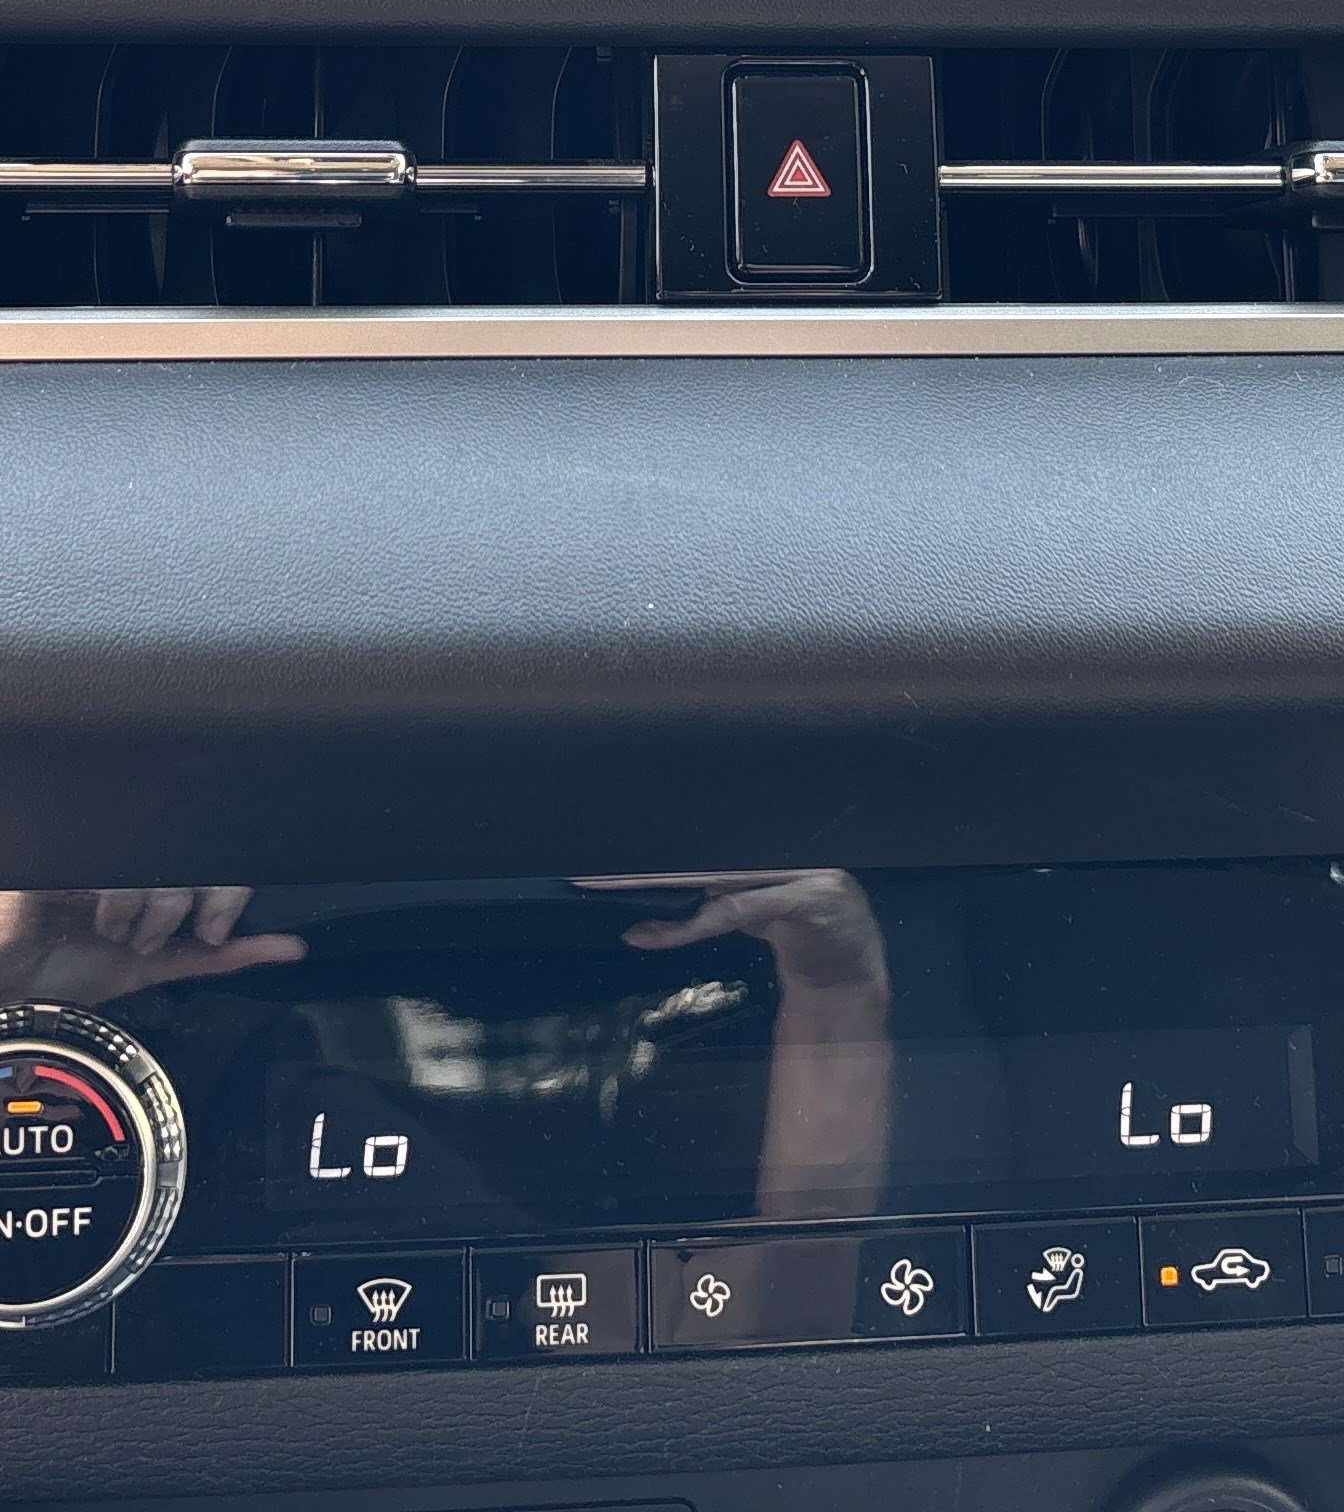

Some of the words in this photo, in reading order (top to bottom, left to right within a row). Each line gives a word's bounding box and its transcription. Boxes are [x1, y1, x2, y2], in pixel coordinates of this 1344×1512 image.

[1119, 1081, 1213, 1147] Lo
[309, 1112, 409, 1179] Lo
[351, 1327, 421, 1352] FRONT
[535, 1323, 588, 1347] REAR
